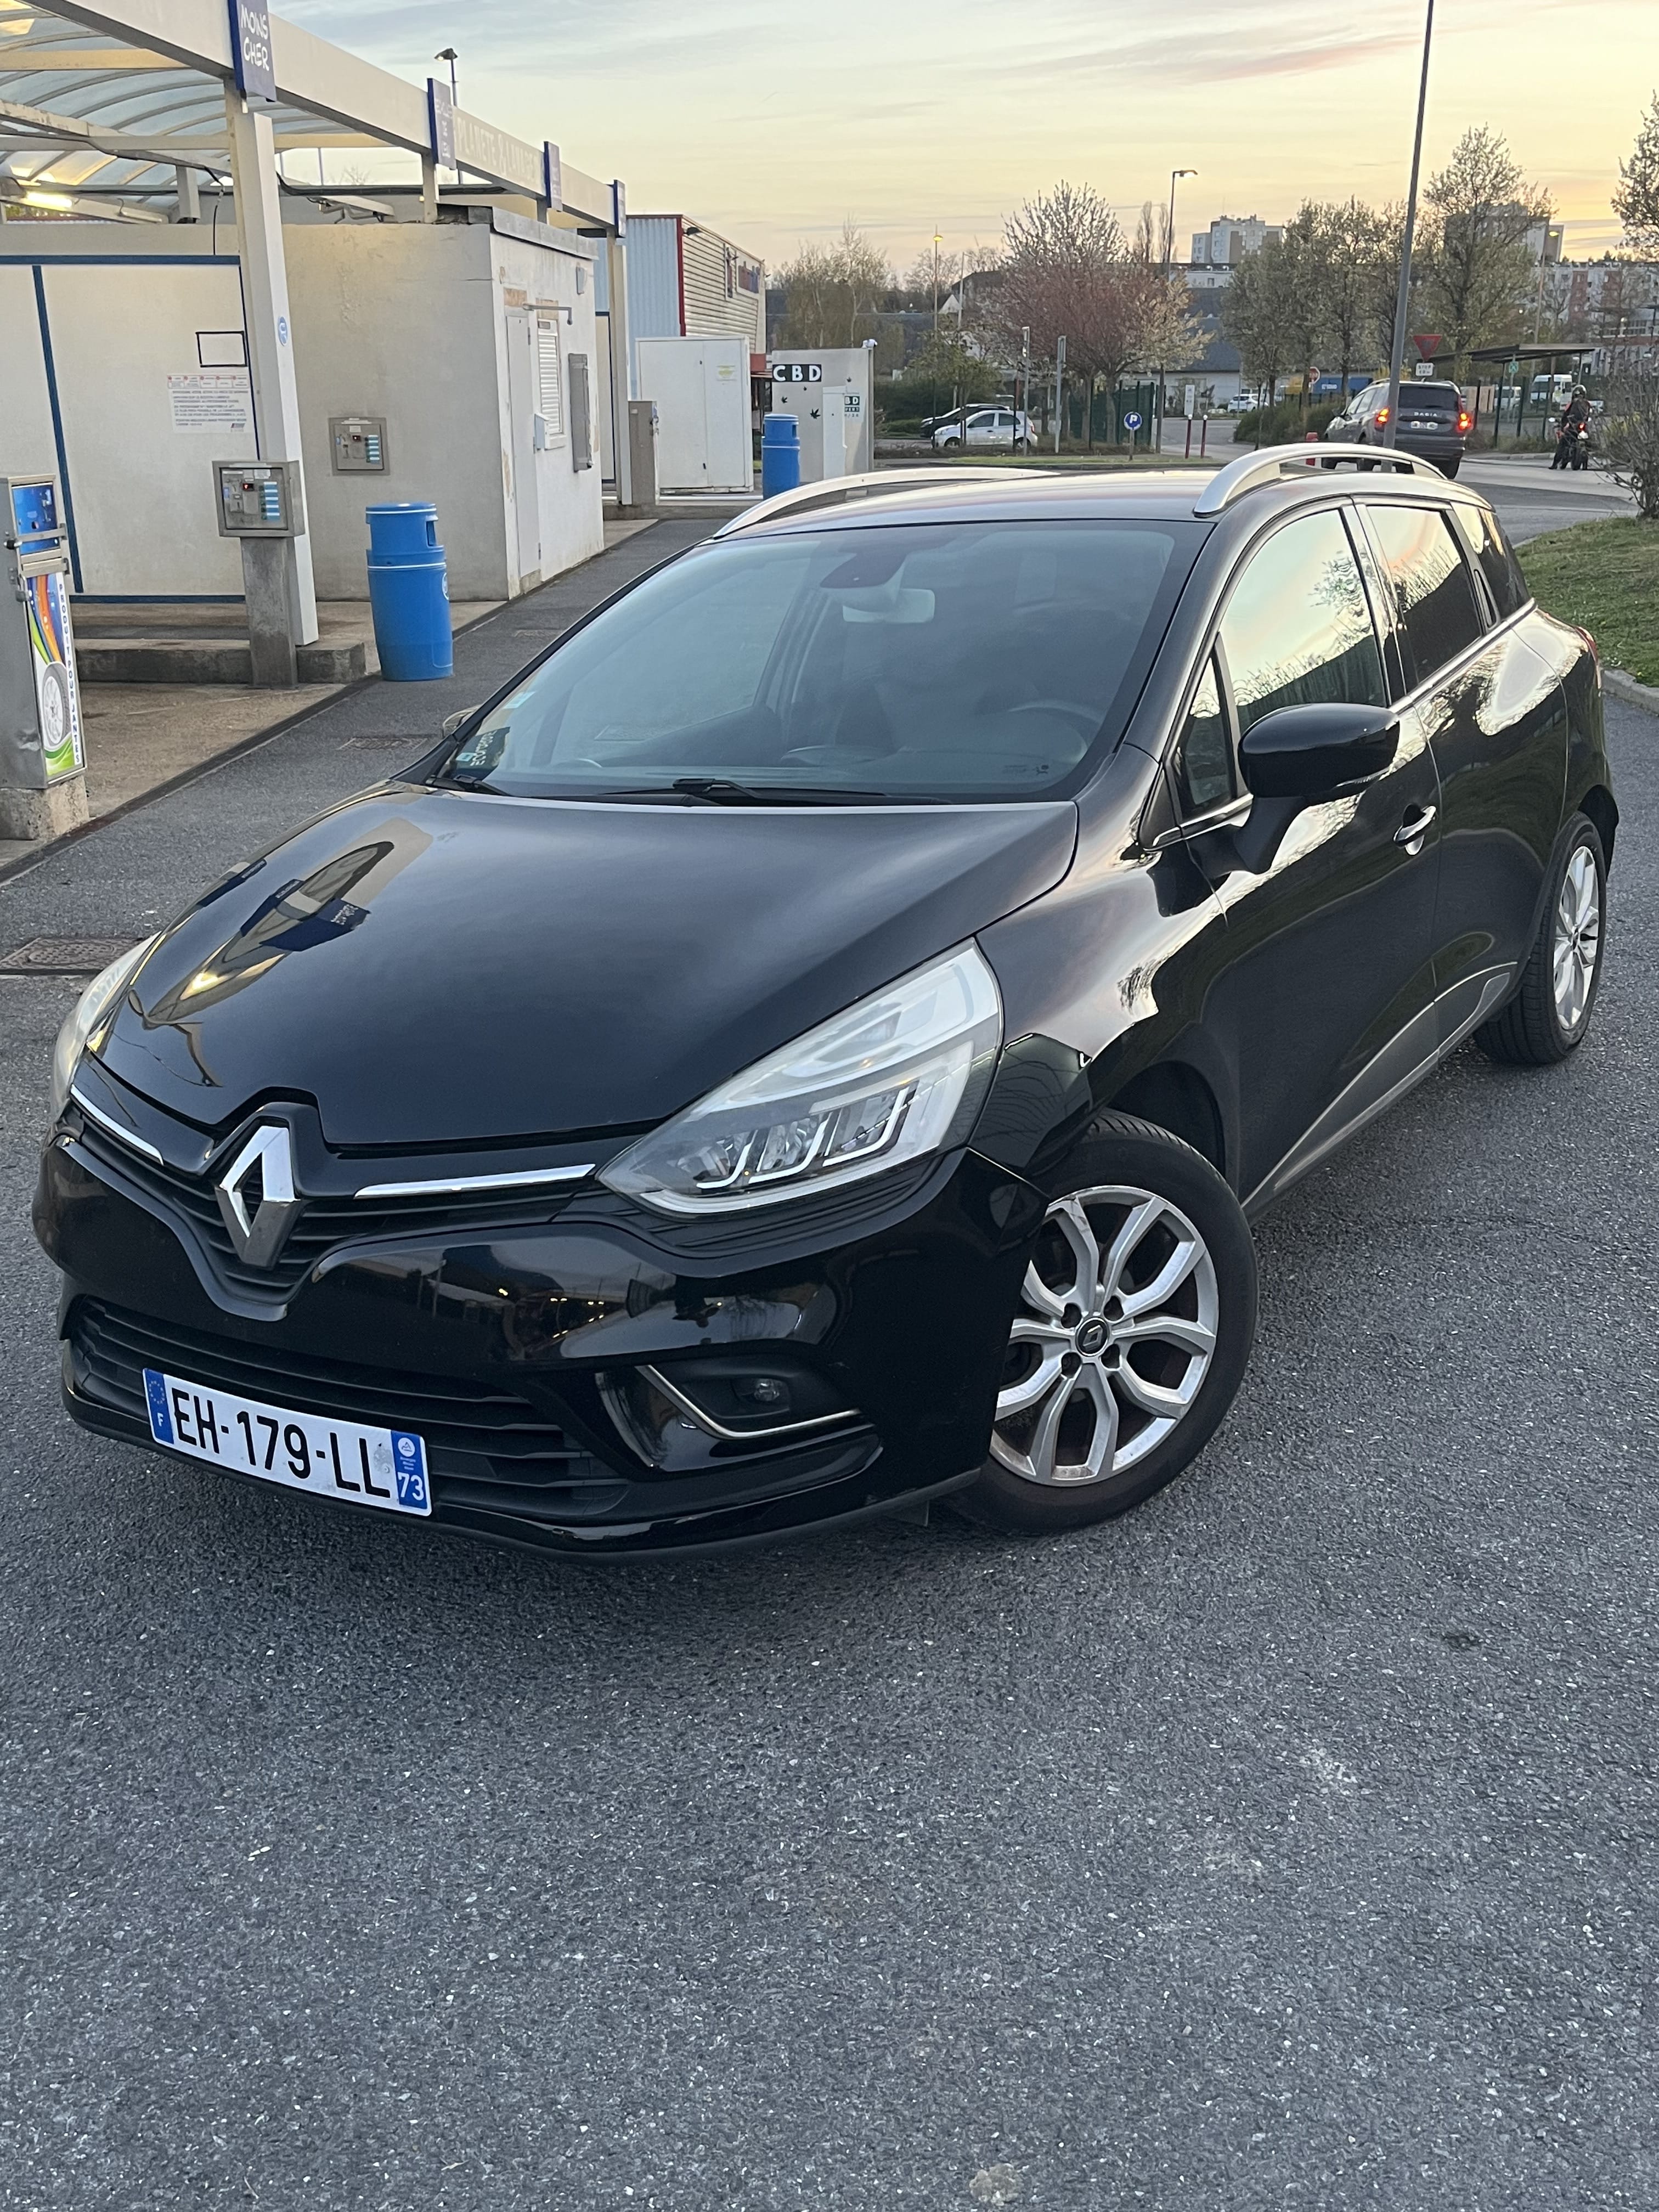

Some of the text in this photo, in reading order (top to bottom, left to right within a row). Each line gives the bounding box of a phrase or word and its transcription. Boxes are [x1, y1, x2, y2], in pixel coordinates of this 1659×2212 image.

[243, 36, 270, 71] CHER
[773, 365, 821, 381] CBD
[1129, 414, 1138, 424] P
[59, 583, 70, 655] PRODUIT
[72, 704, 80, 763] JANTES
[157, 1412, 163, 1427] F
[171, 1387, 391, 1498] EH-179-LL
[397, 1471, 425, 1501] 73
